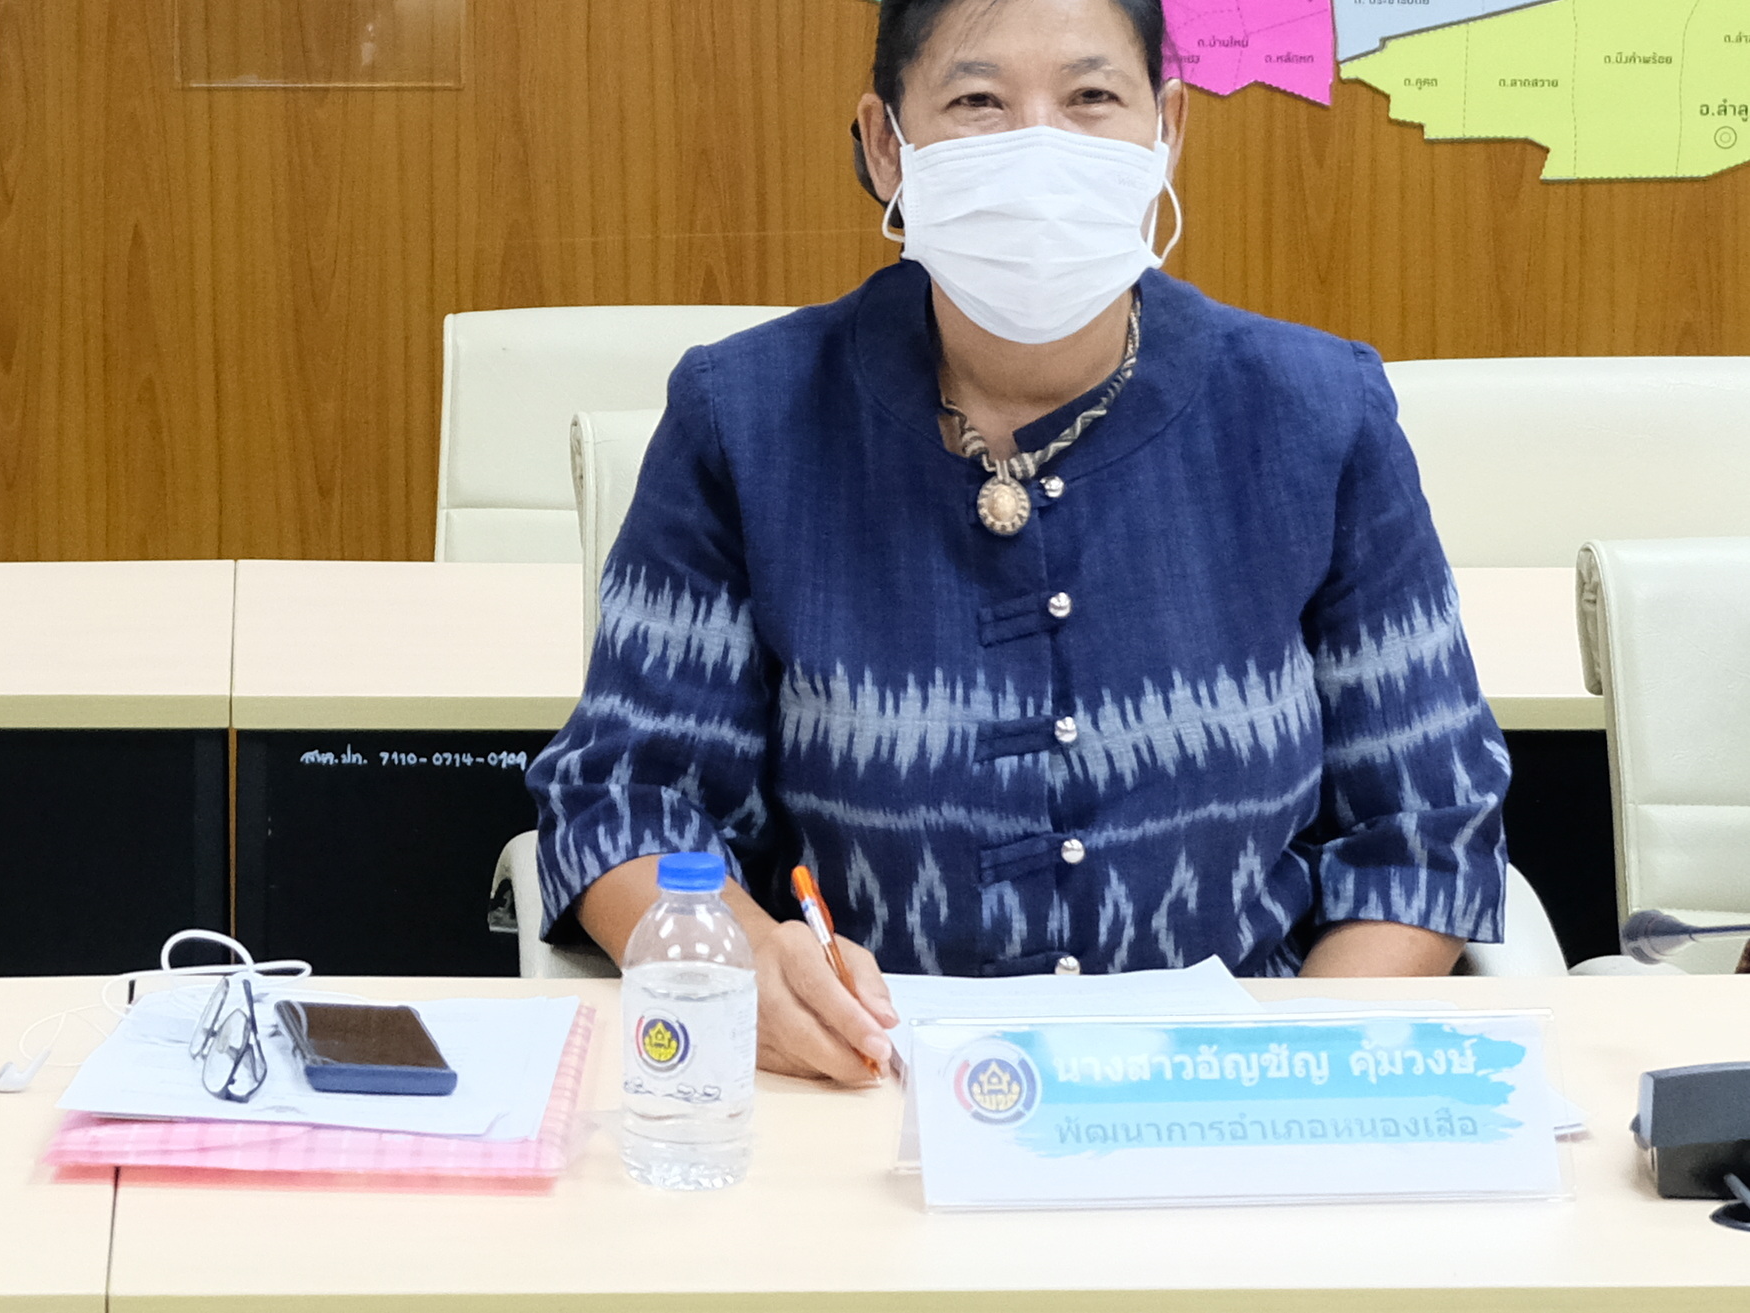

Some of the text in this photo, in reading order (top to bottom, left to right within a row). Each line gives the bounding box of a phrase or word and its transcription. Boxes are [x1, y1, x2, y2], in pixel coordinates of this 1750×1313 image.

[1604, 52, 1673, 65] ต.บึงคำพร้อย
[1403, 77, 1438, 89] ต.คูคต
[1499, 78, 1558, 88] ต.ลาดสวาย
[1699, 98, 1749, 122] อ.ลำลู
[1052, 1045, 1328, 1086] นางสาวอัญชัญ
[1055, 1107, 1478, 1145] พัฒนาการอำเภอหนองเสือ
